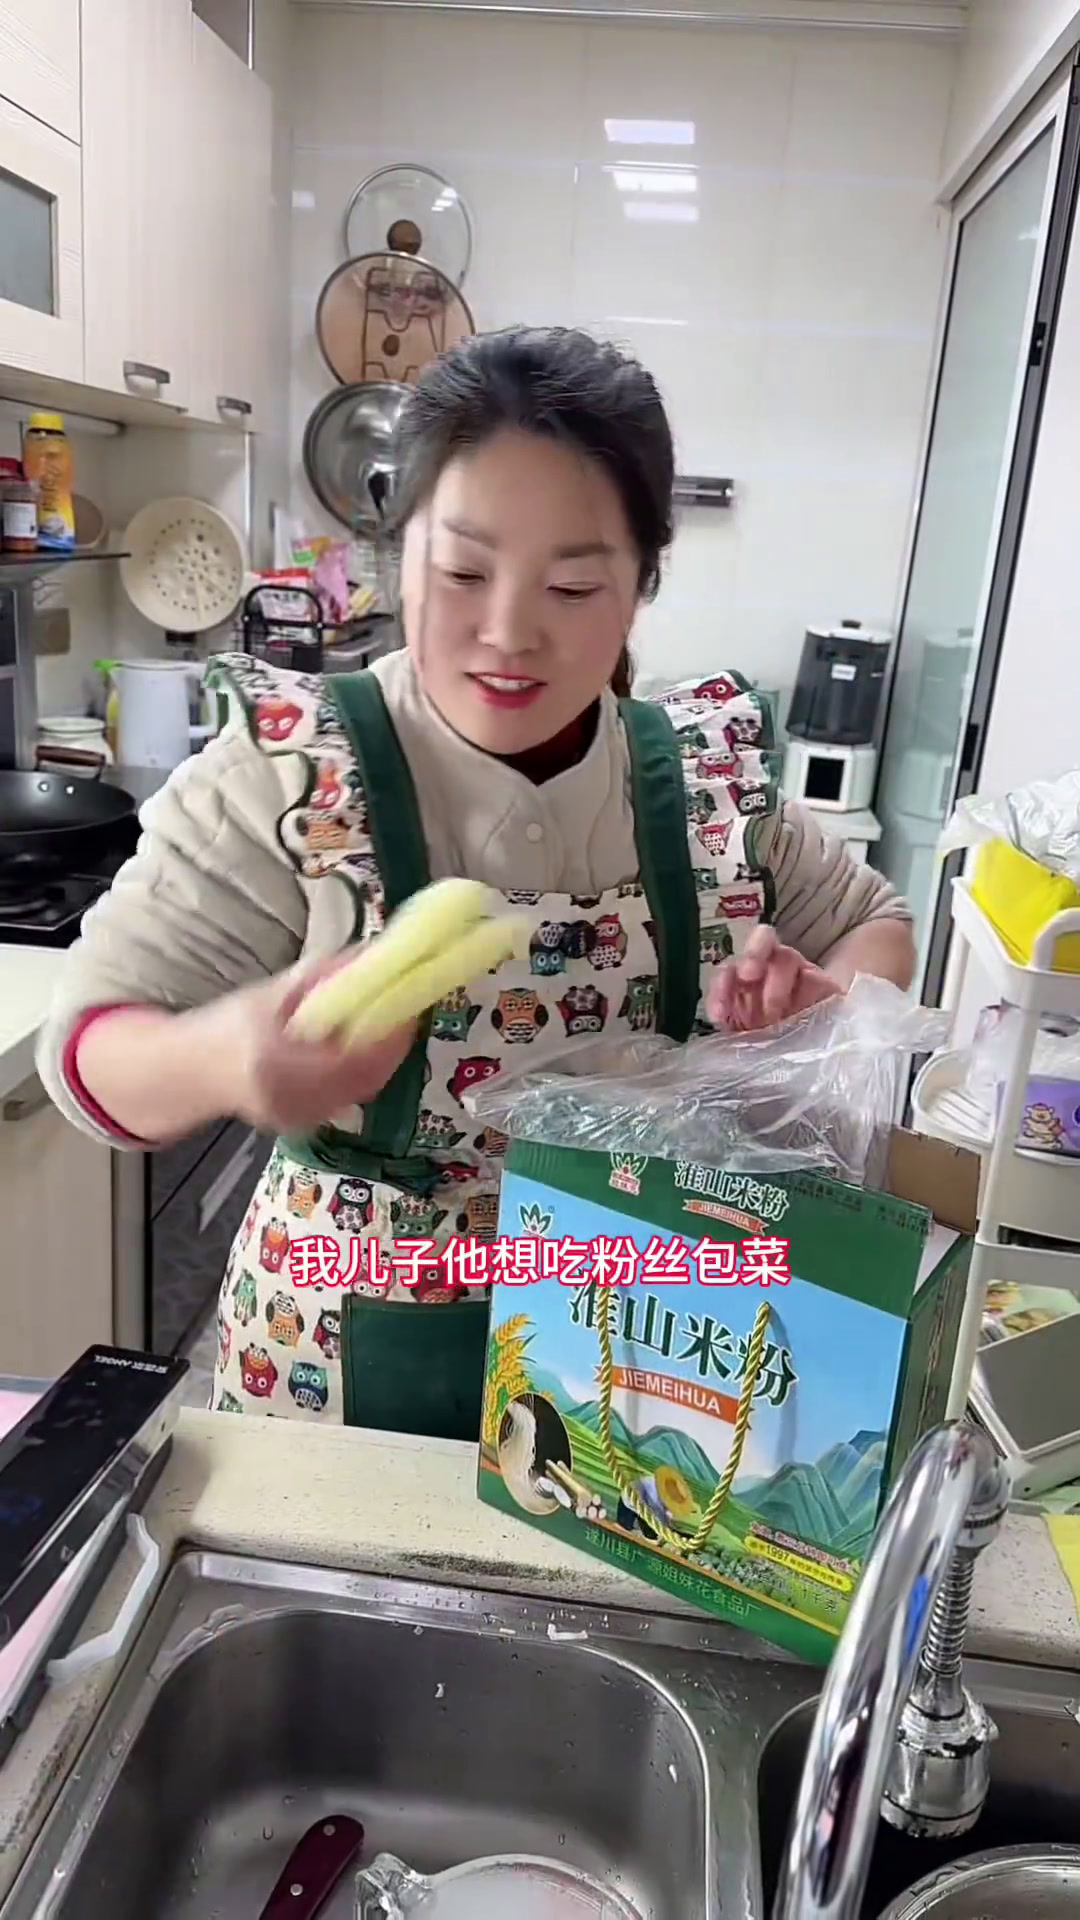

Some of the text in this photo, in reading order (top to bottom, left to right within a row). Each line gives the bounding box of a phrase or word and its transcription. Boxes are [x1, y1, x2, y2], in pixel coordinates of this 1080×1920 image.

[674, 1160, 790, 1221] 淮山米粉
[699, 1203, 750, 1227] JIEMEIHUA
[570, 1283, 797, 1405] 淮山米粉
[619, 1368, 721, 1414] JIEMEIHUA
